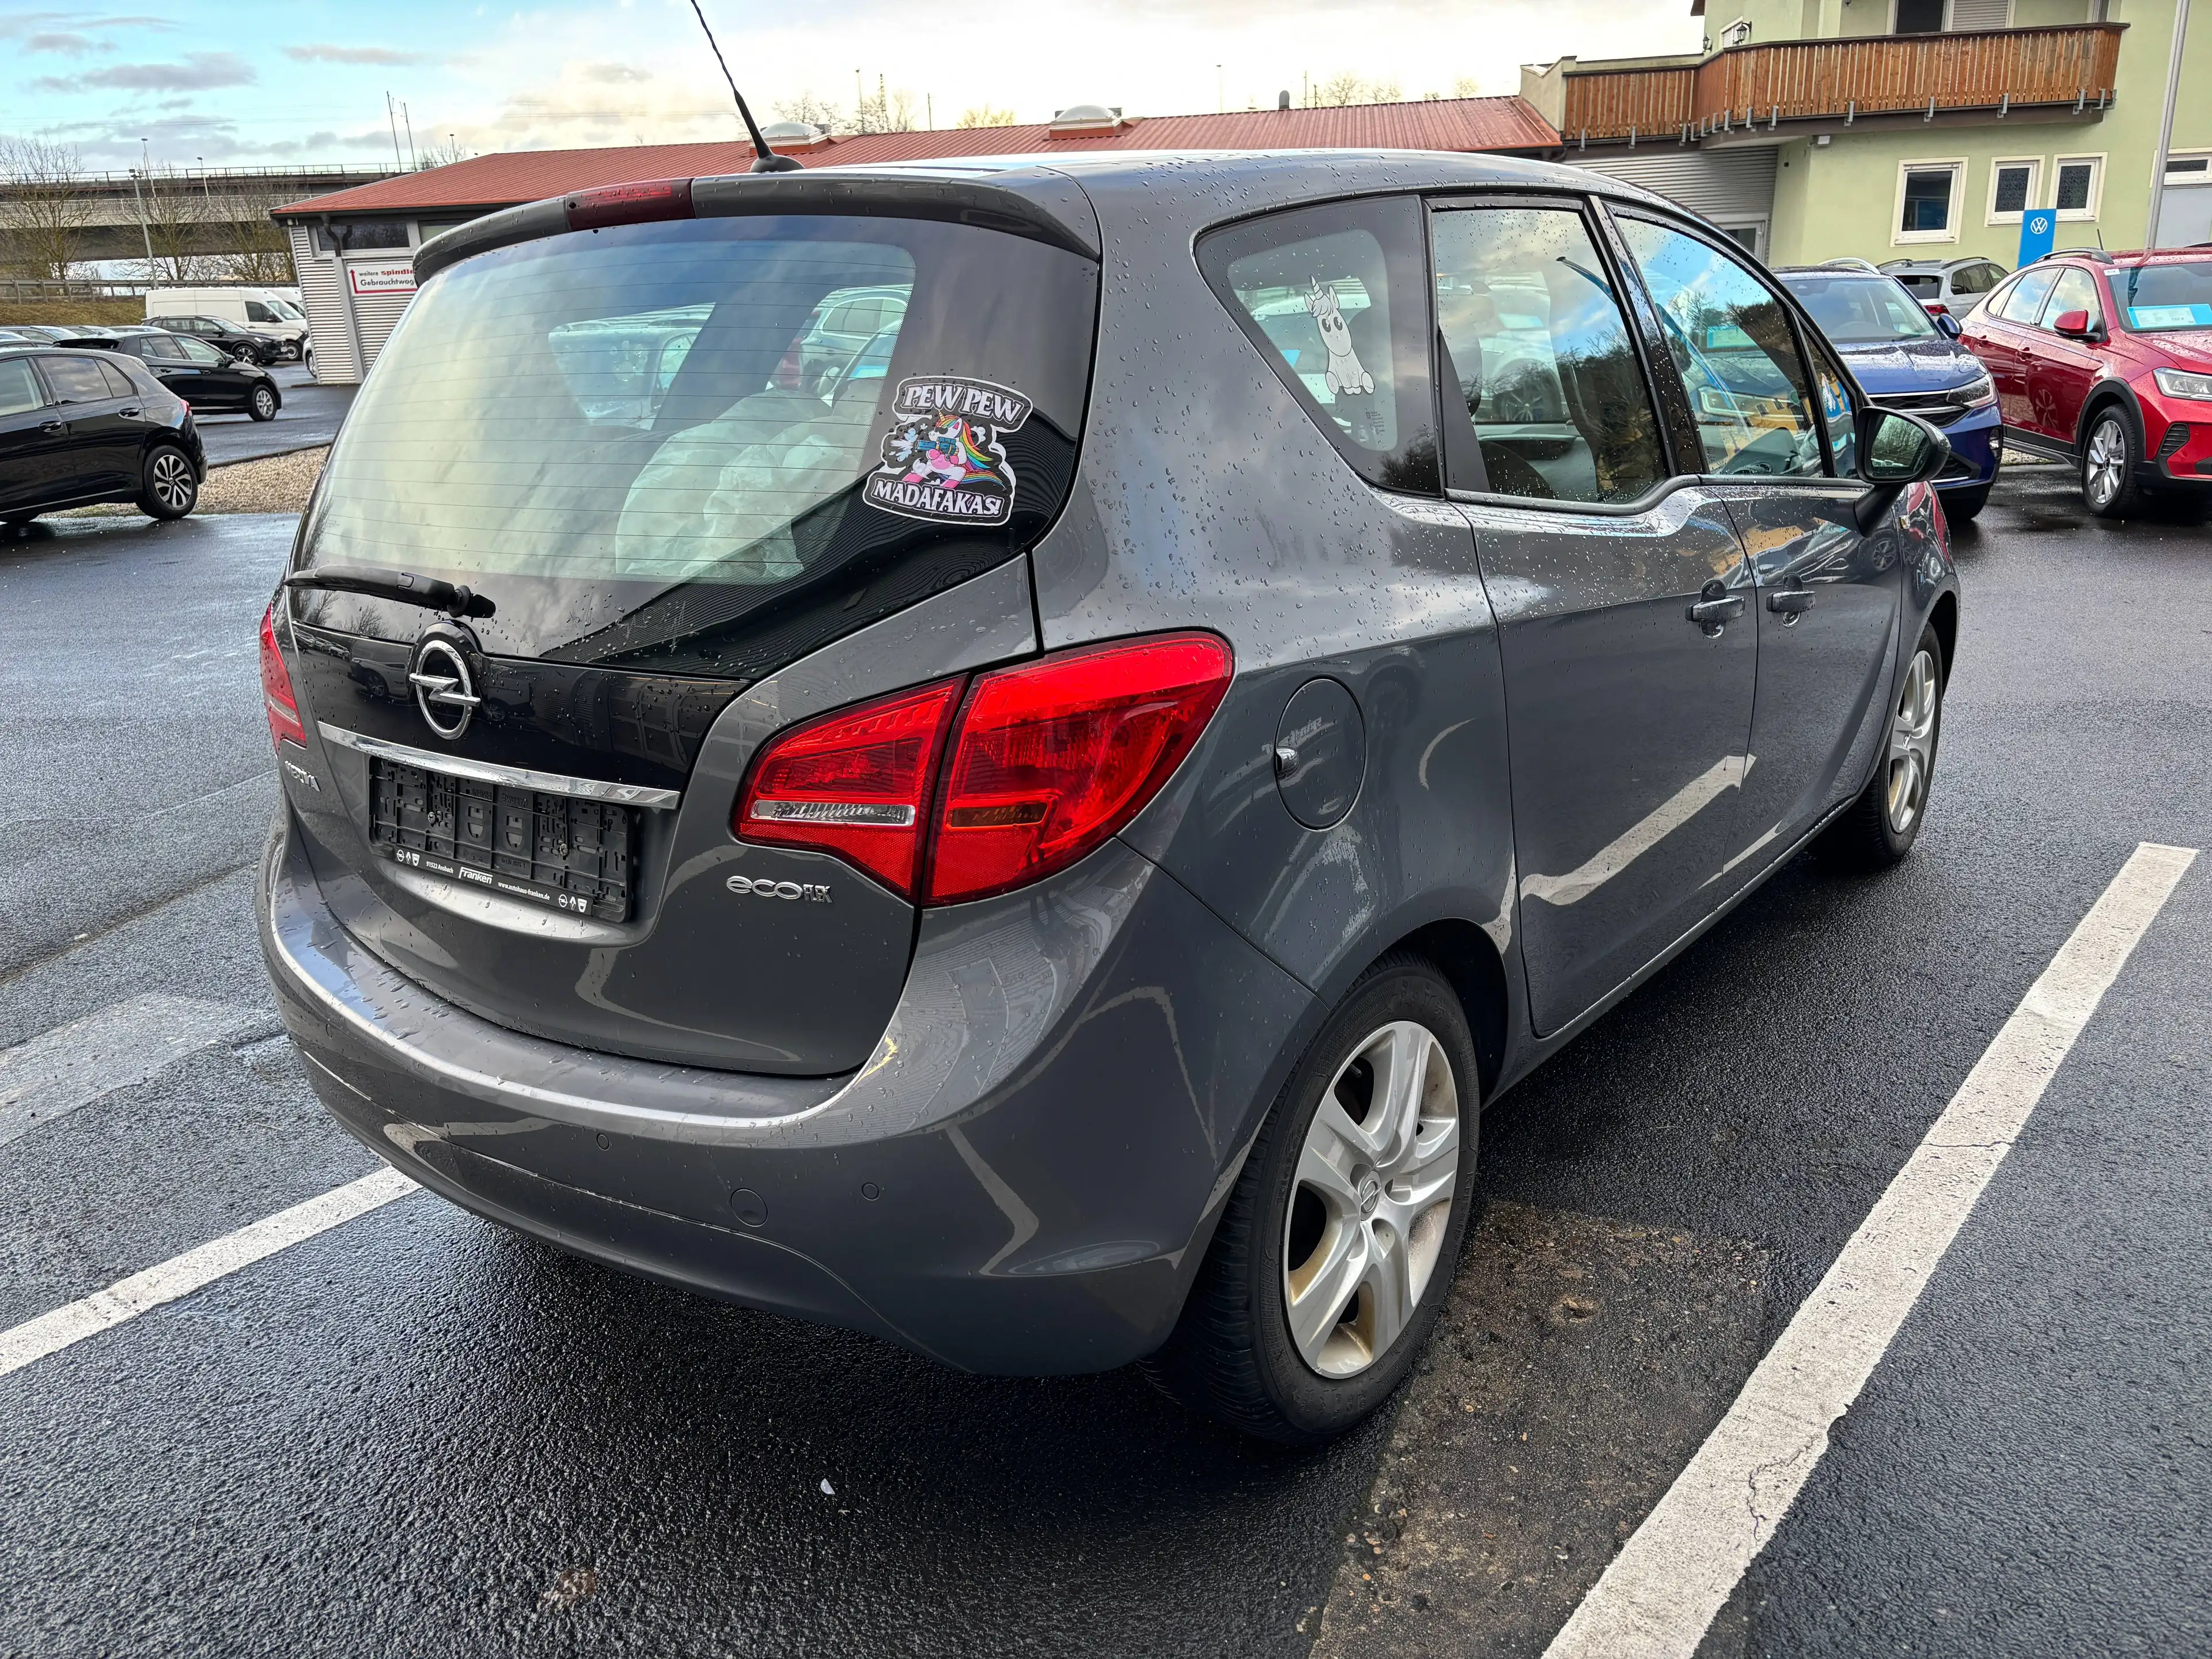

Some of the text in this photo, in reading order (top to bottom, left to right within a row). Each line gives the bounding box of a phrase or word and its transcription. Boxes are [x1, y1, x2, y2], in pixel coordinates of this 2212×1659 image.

[902, 385, 1021, 422] PEW PEW
[872, 480, 1003, 516] MADAFAKAS!
[426, 861, 454, 874] 91522 Ansbach
[459, 866, 493, 884] Franken
[498, 881, 550, 900] www.autohaus-franken.de
